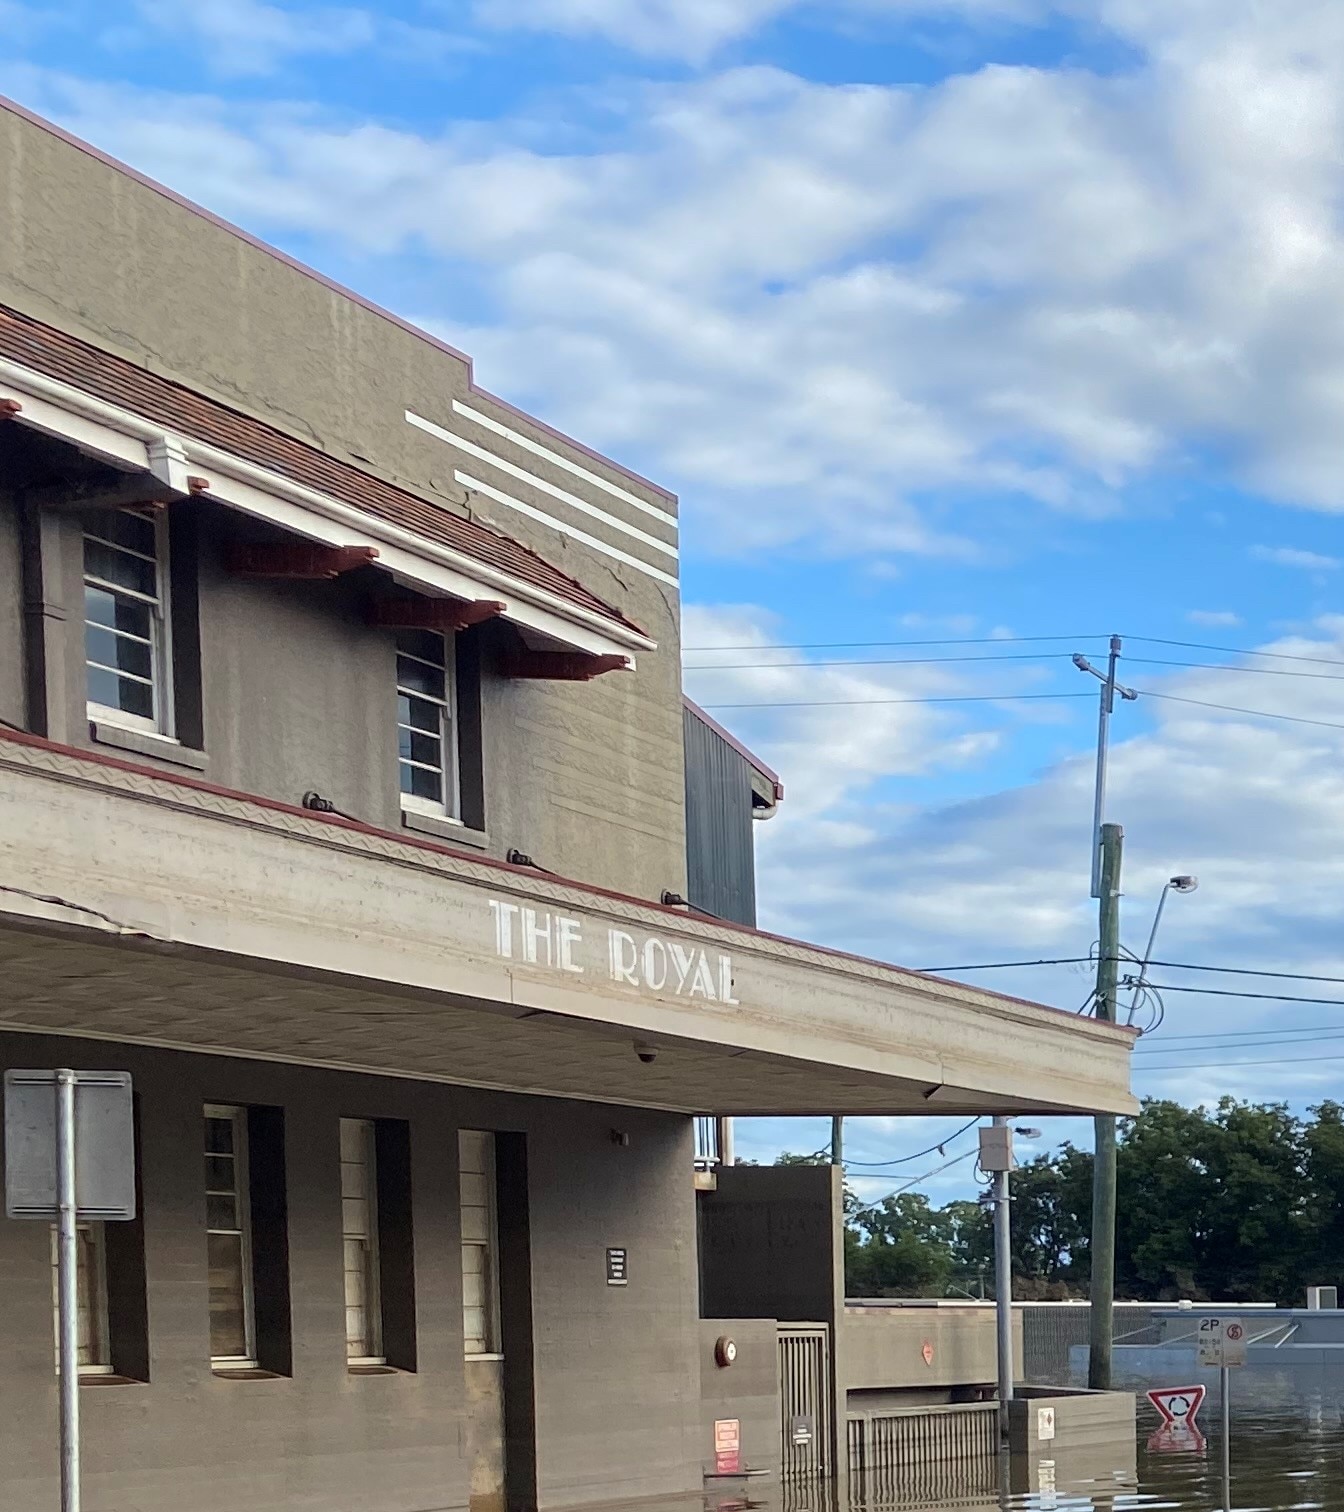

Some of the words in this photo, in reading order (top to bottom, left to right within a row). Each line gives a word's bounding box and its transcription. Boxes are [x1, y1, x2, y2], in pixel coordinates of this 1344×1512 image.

[489, 899, 584, 973] THE
[608, 928, 740, 1005] ROYAL
[1200, 1319, 1219, 1331] 2P
